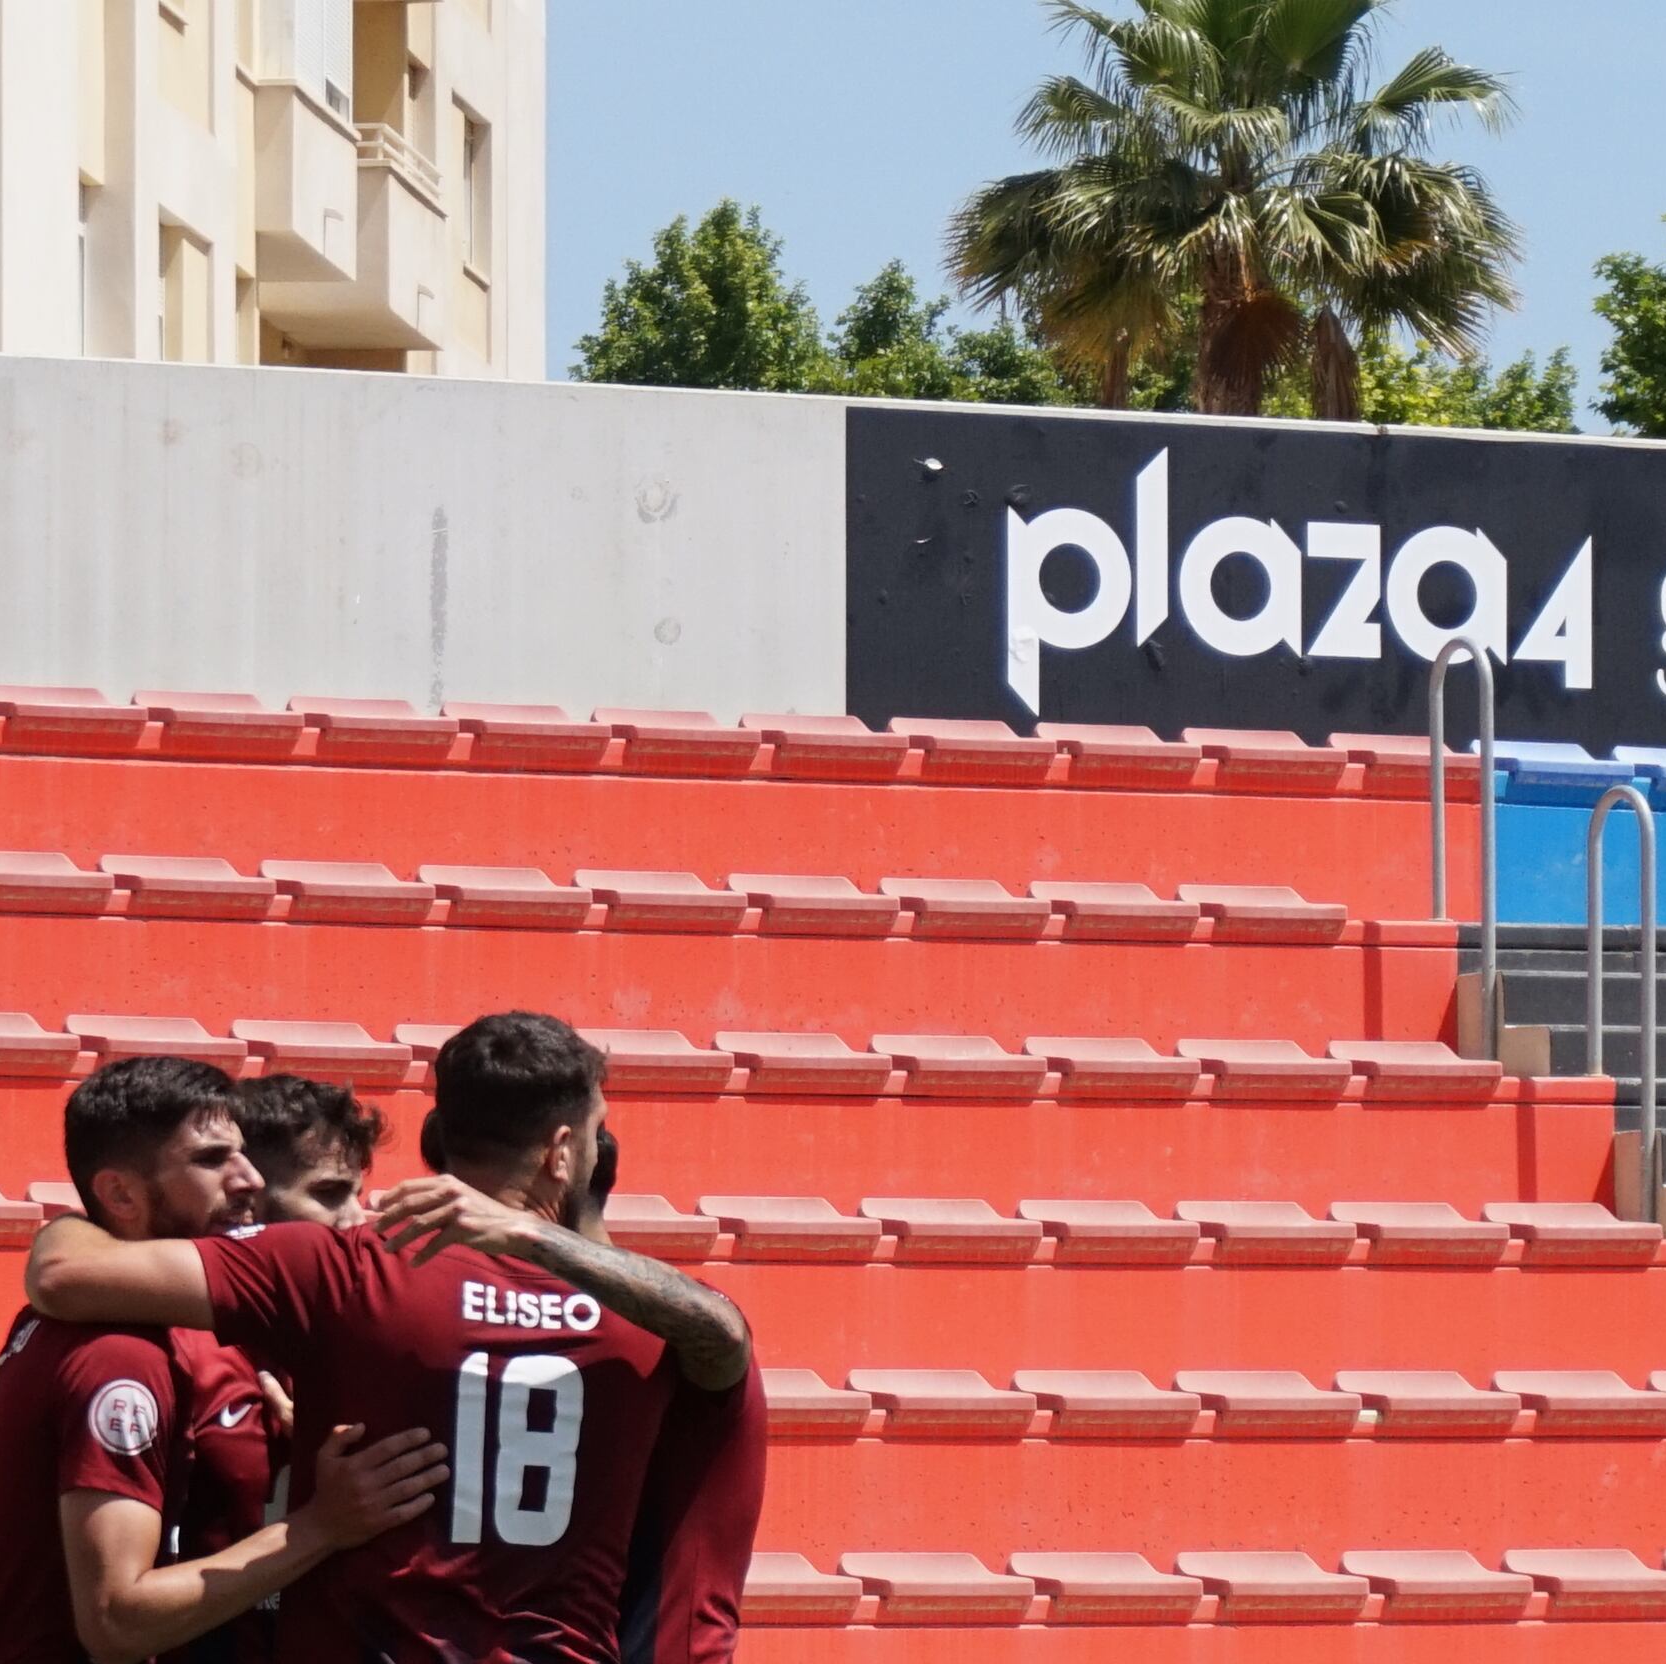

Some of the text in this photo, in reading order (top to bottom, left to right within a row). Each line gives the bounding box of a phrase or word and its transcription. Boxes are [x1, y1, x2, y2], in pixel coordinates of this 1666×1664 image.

[1008, 446, 1592, 717] plaza4
[463, 1281, 601, 1331] ELISEO
[451, 1352, 584, 1547] 18
